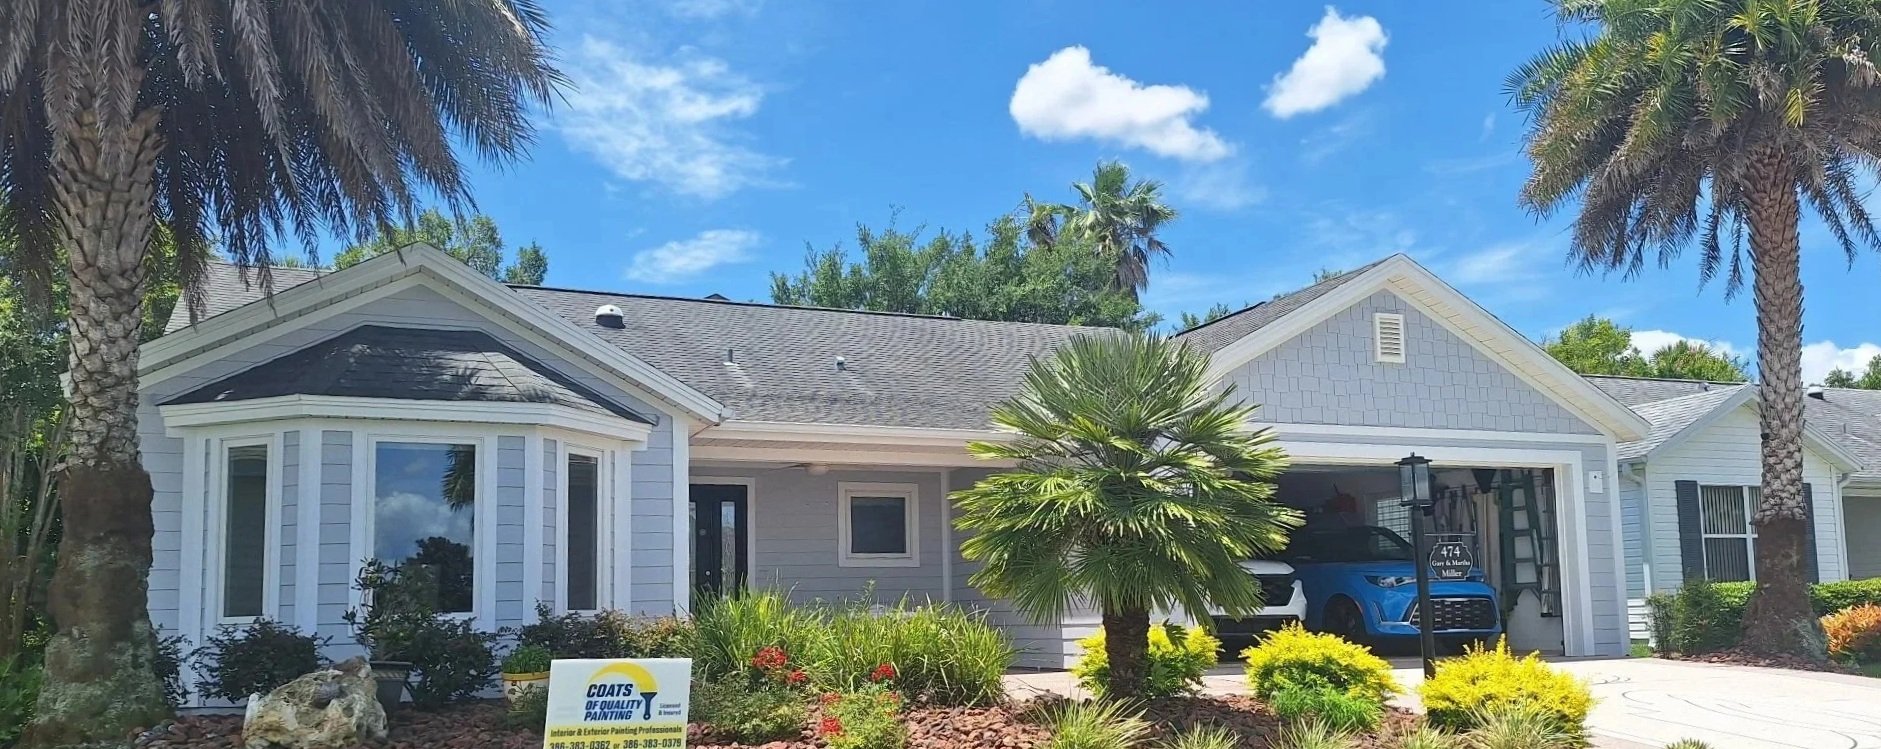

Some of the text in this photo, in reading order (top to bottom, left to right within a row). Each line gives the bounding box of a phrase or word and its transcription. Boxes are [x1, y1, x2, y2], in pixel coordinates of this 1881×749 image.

[1440, 545, 1461, 557] 474
[1441, 568, 1463, 577] Miller
[586, 683, 633, 698] COATS
[584, 699, 643, 711] OF QUALITY
[584, 710, 632, 722] PAINTING
[550, 725, 682, 737] Interior & Exterior Painting Professionals
[622, 738, 682, 749] 386-383-0379
